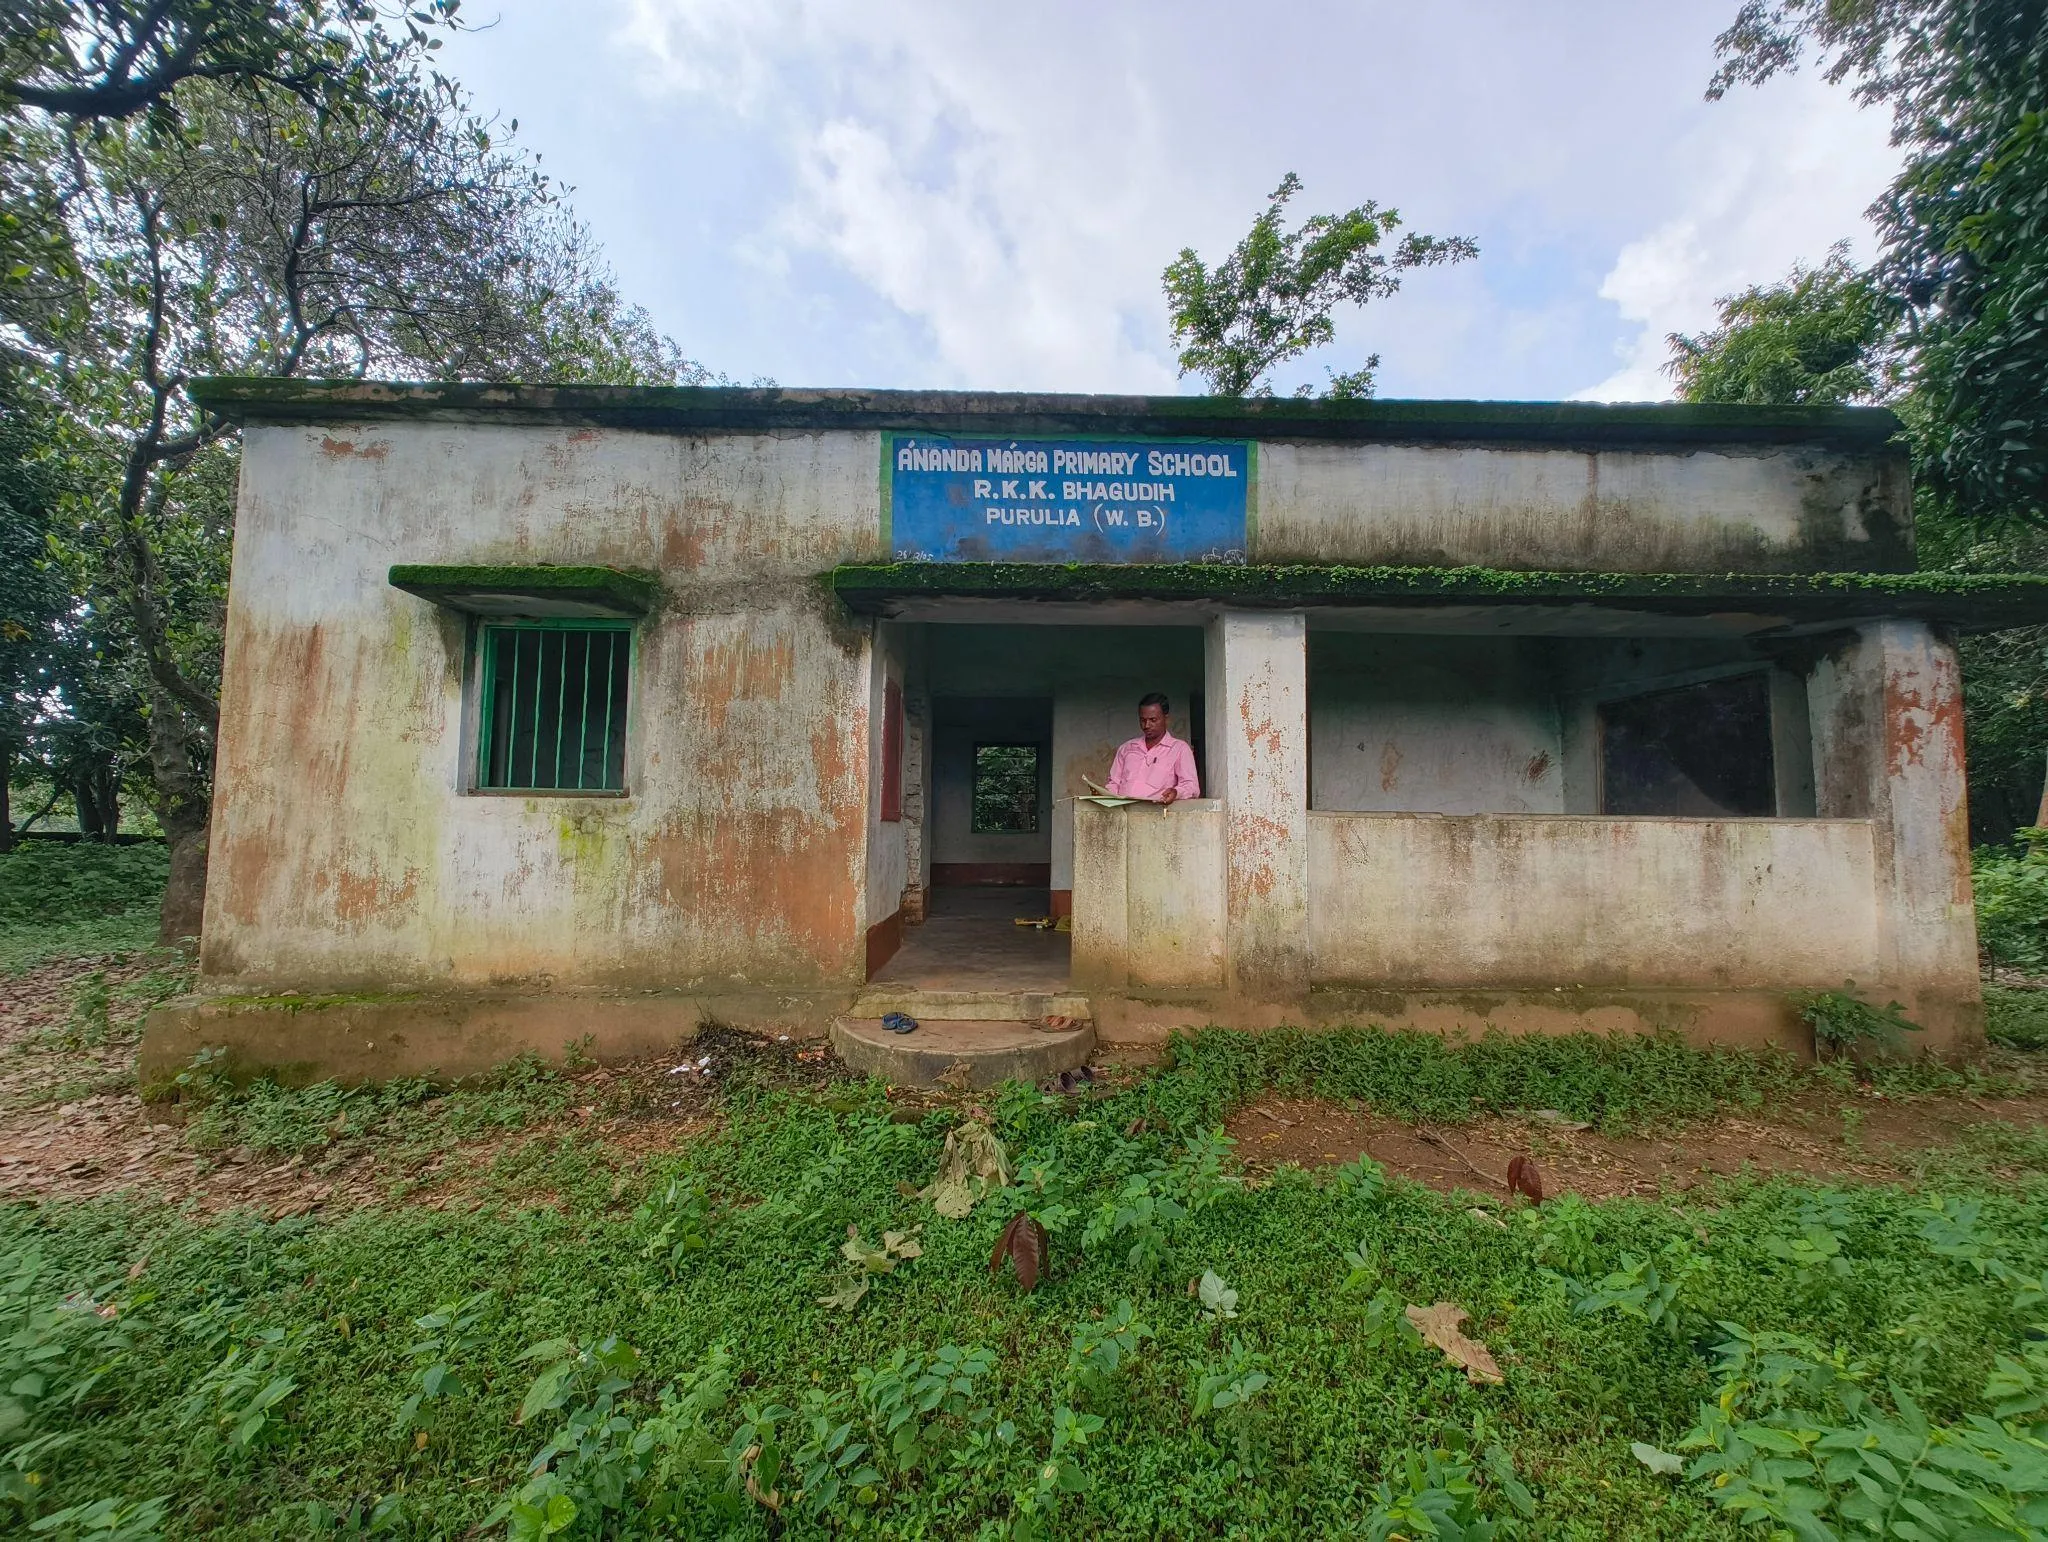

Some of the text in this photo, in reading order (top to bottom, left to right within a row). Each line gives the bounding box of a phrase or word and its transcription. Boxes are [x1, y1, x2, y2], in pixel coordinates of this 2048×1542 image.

[1054, 449, 1139, 475] PRIMARY
[1148, 450, 1237, 477] SCHOOL
[1063, 482, 1175, 501] BHAGUDIH
[986, 508, 1080, 526] PURULIA
